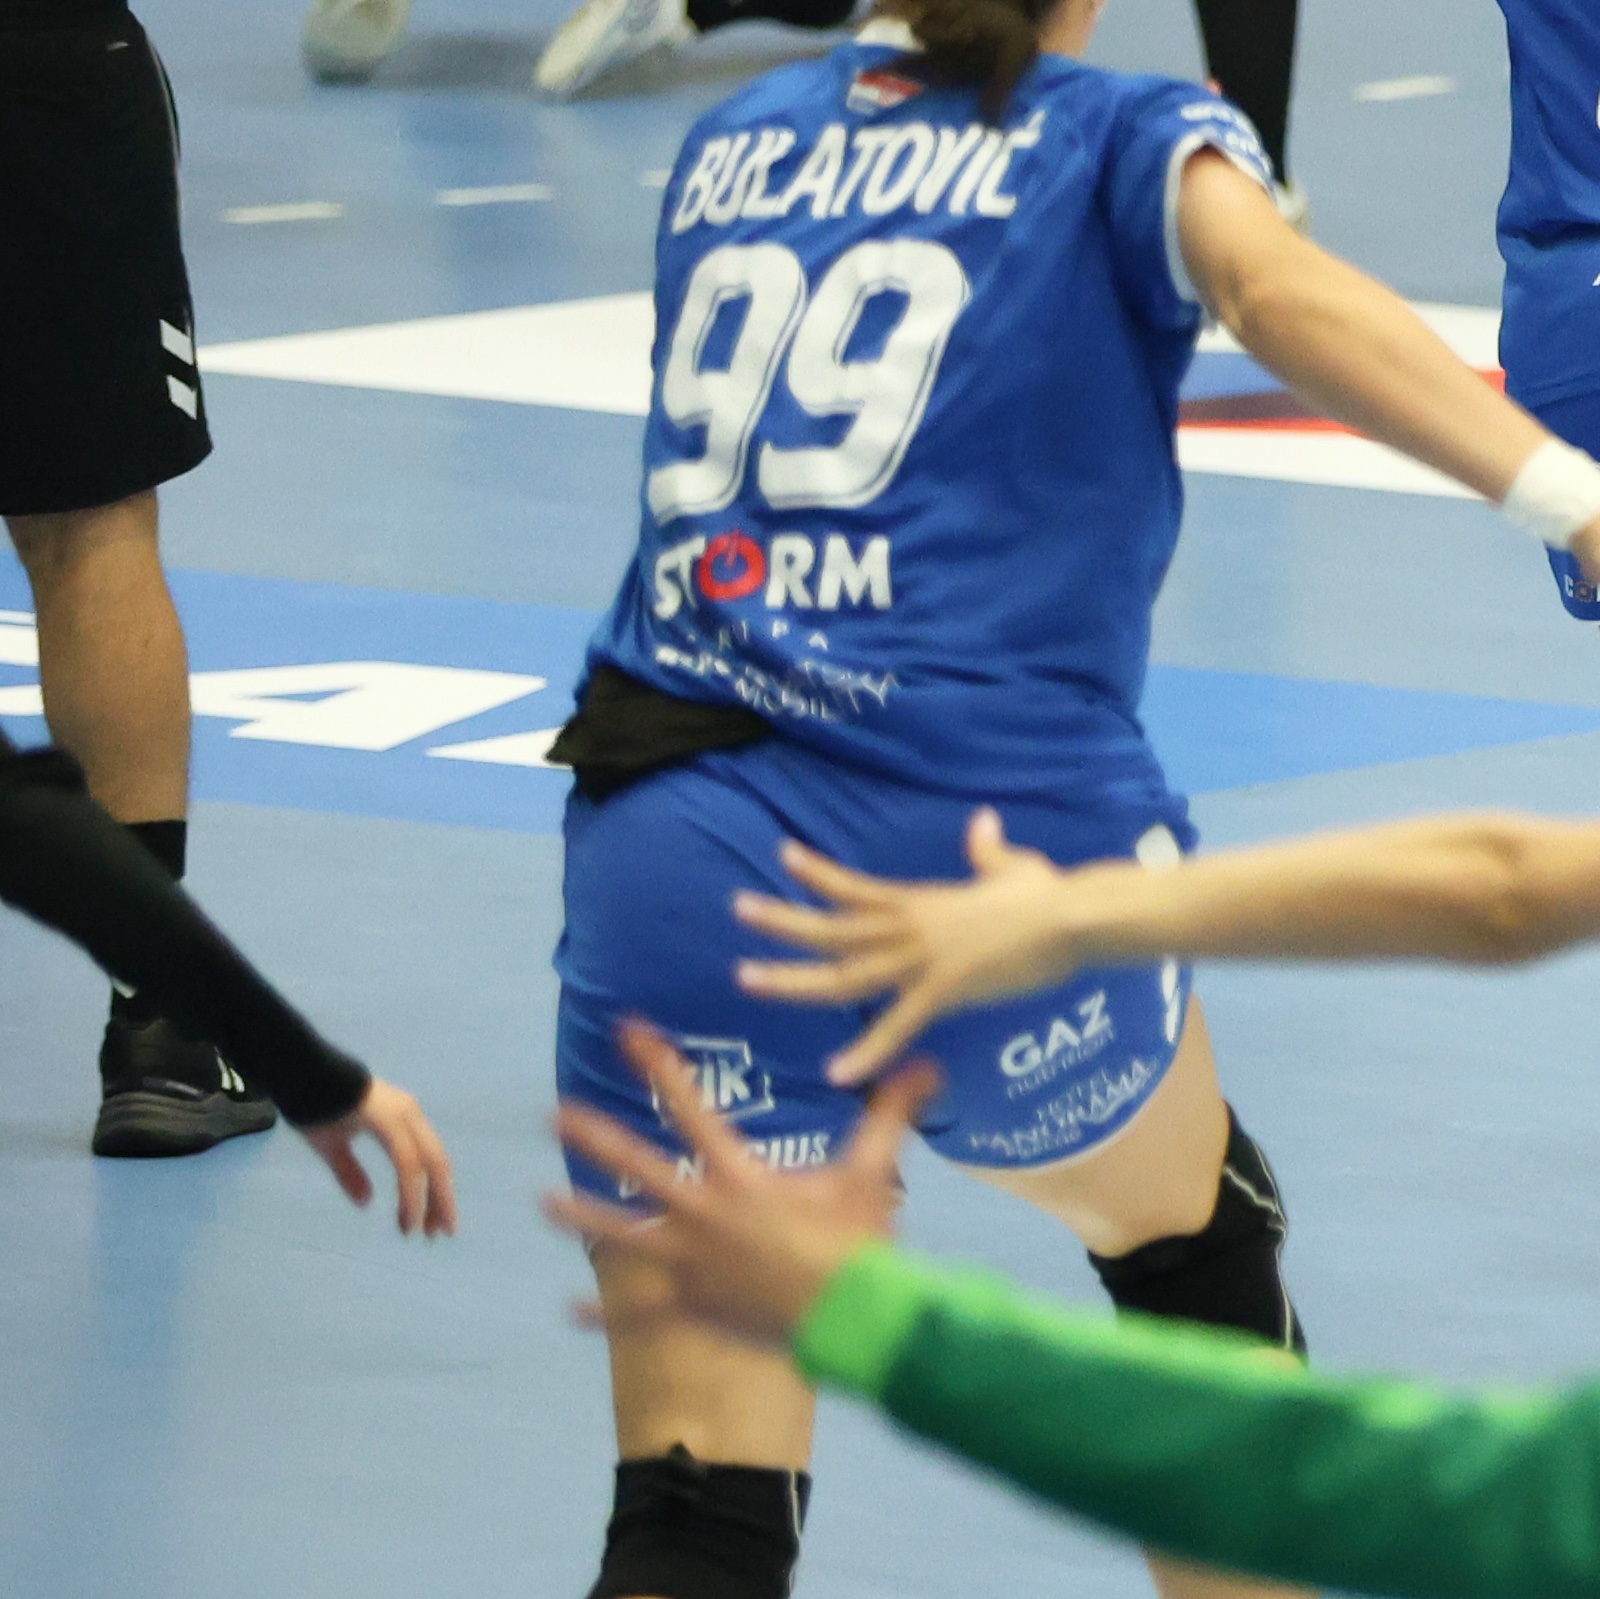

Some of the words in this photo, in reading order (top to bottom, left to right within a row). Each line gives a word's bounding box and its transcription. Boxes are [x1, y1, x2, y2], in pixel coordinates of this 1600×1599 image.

[648, 240, 972, 522] 99
[653, 529, 893, 621] STORM
[1001, 988, 1111, 1078] GAZ
